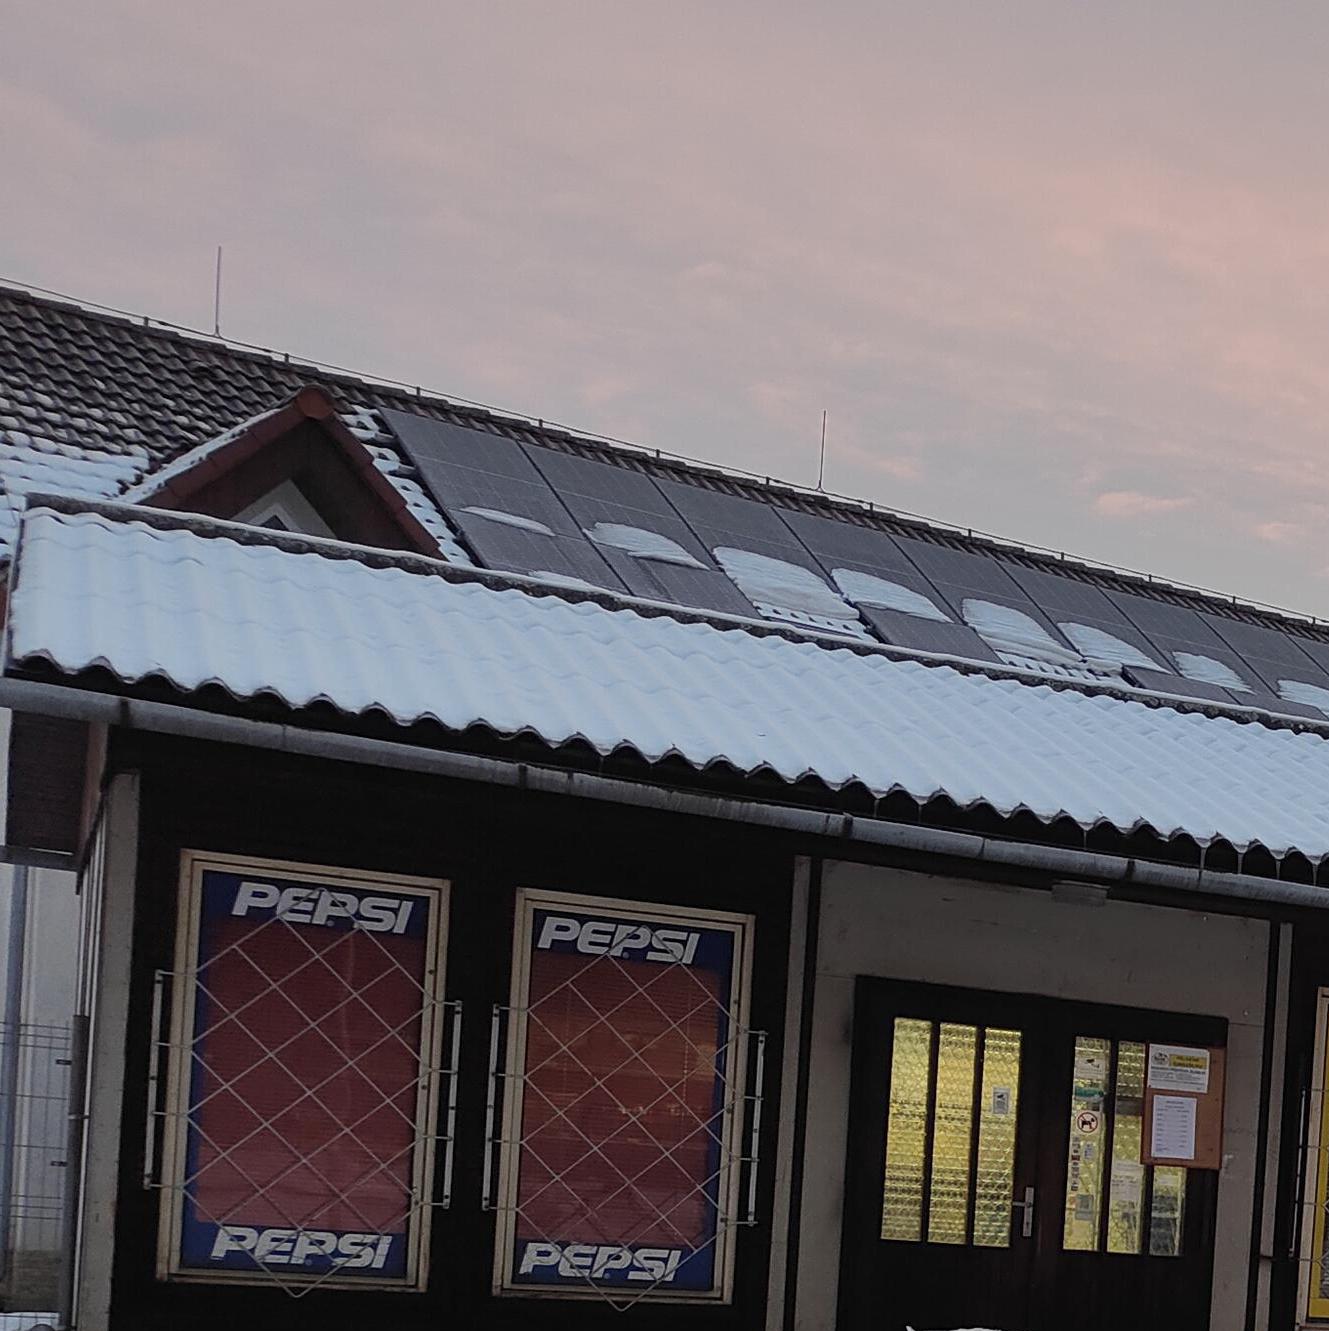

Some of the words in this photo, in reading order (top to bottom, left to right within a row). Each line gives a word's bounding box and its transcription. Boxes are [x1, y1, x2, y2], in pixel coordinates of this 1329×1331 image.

[231, 881, 414, 935] PEPSI
[537, 916, 701, 965] PEPSI
[210, 1226, 392, 1269] PEPSI
[519, 1242, 682, 1282] PEPSI
